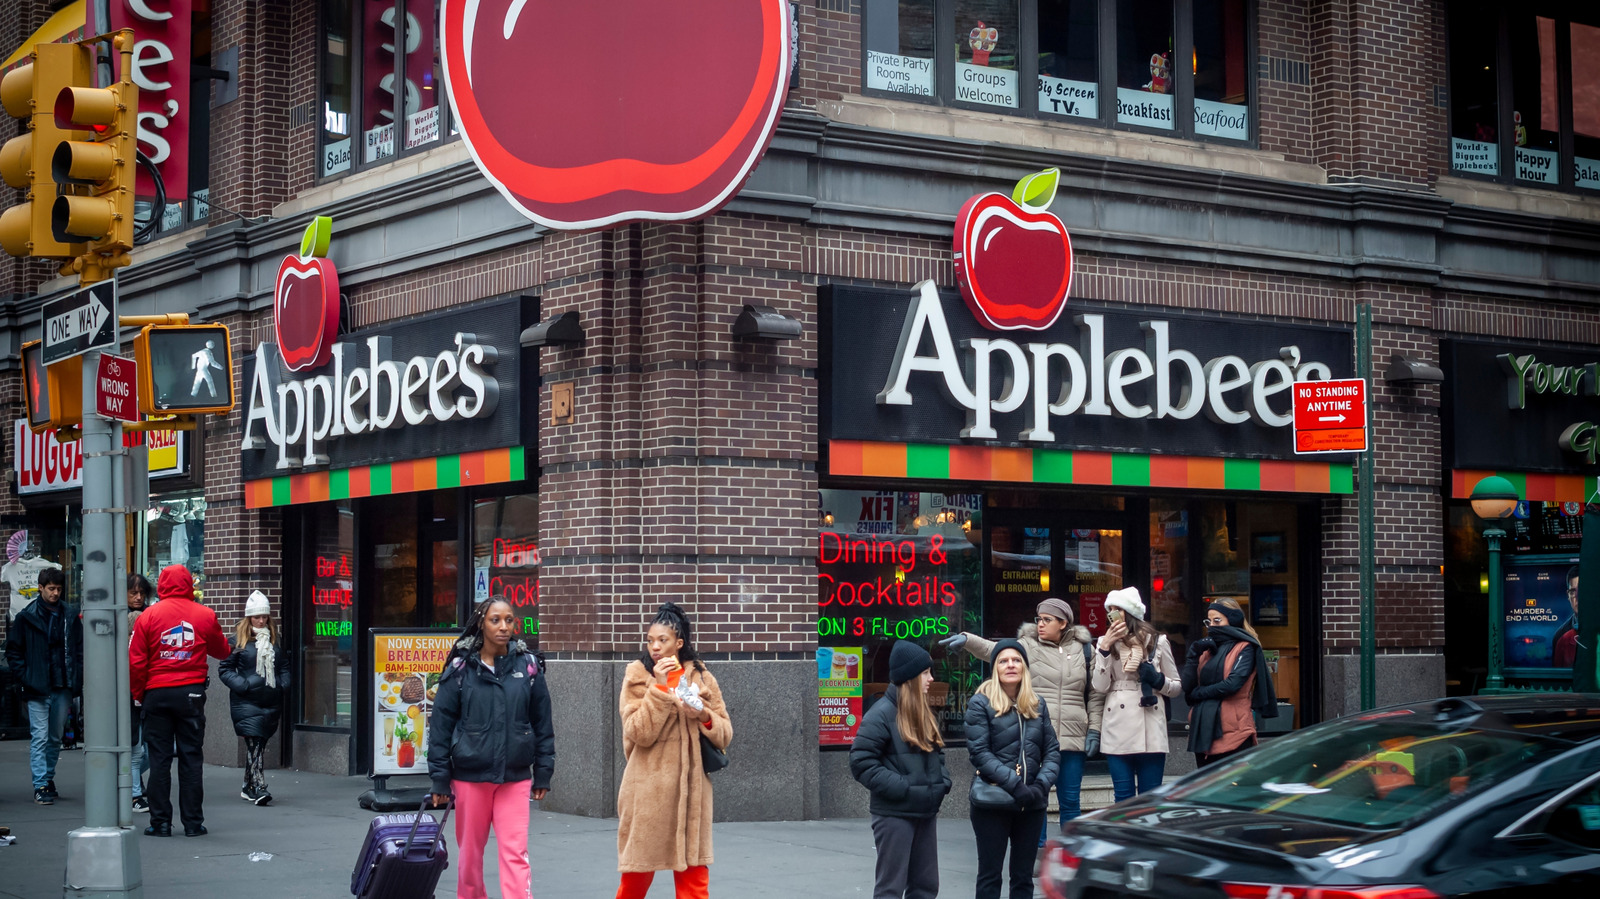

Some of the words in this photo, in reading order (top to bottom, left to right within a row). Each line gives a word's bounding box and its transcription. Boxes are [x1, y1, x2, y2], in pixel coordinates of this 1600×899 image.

[867, 52, 899, 67] Private
[903, 57, 930, 73] Party
[876, 66, 910, 81] Rooms
[963, 69, 1006, 88] Groups
[887, 81, 930, 96] Available
[957, 86, 1012, 105] Welcome
[1038, 78, 1052, 96] Big
[1056, 83, 1095, 99] Screen
[1050, 98, 1080, 115] TVs
[1117, 98, 1171, 121] Breakfast
[414, 110, 439, 126] World's
[1194, 106, 1246, 131] Seafood
[368, 127, 394, 146] SPORT
[376, 143, 392, 159] BAR
[1455, 142, 1489, 151] World's
[1455, 152, 1489, 161] Biggest
[1516, 150, 1551, 169] Happy
[1452, 162, 1497, 170] pplebee's!
[1520, 167, 1547, 181] Hour
[51, 315, 71, 342] ONE
[78, 304, 100, 333] WAY
[101, 377, 129, 397] WRONG
[1496, 353, 1587, 409] Your
[241, 332, 499, 469] Applebee's
[1299, 388, 1311, 398] NO
[1316, 386, 1358, 398] STANDING
[105, 395, 123, 413] WAY
[1307, 400, 1352, 412] ANYTIME
[149, 429, 176, 449] SALE
[820, 532, 916, 573] Dining
[928, 534, 947, 565] &
[316, 556, 337, 577] Bar
[340, 555, 351, 576] &
[477, 571, 486, 590] A
[1002, 571, 1040, 580] ENTRANCE
[818, 573, 956, 607] Cocktails
[995, 584, 1006, 592] ON
[1068, 584, 1079, 593] ON
[312, 585, 353, 610] Lounge
[316, 621, 327, 636] IN
[327, 621, 353, 636] REAR
[524, 617, 539, 634] FL
[818, 617, 846, 636] ON
[853, 617, 865, 636] 3
[871, 616, 949, 639] FLOORS
[388, 638, 413, 649] NOW
[385, 663, 441, 672] 8AM-12NOON
[819, 707, 849, 715] VERAGES
[821, 716, 841, 724] TO-GO
